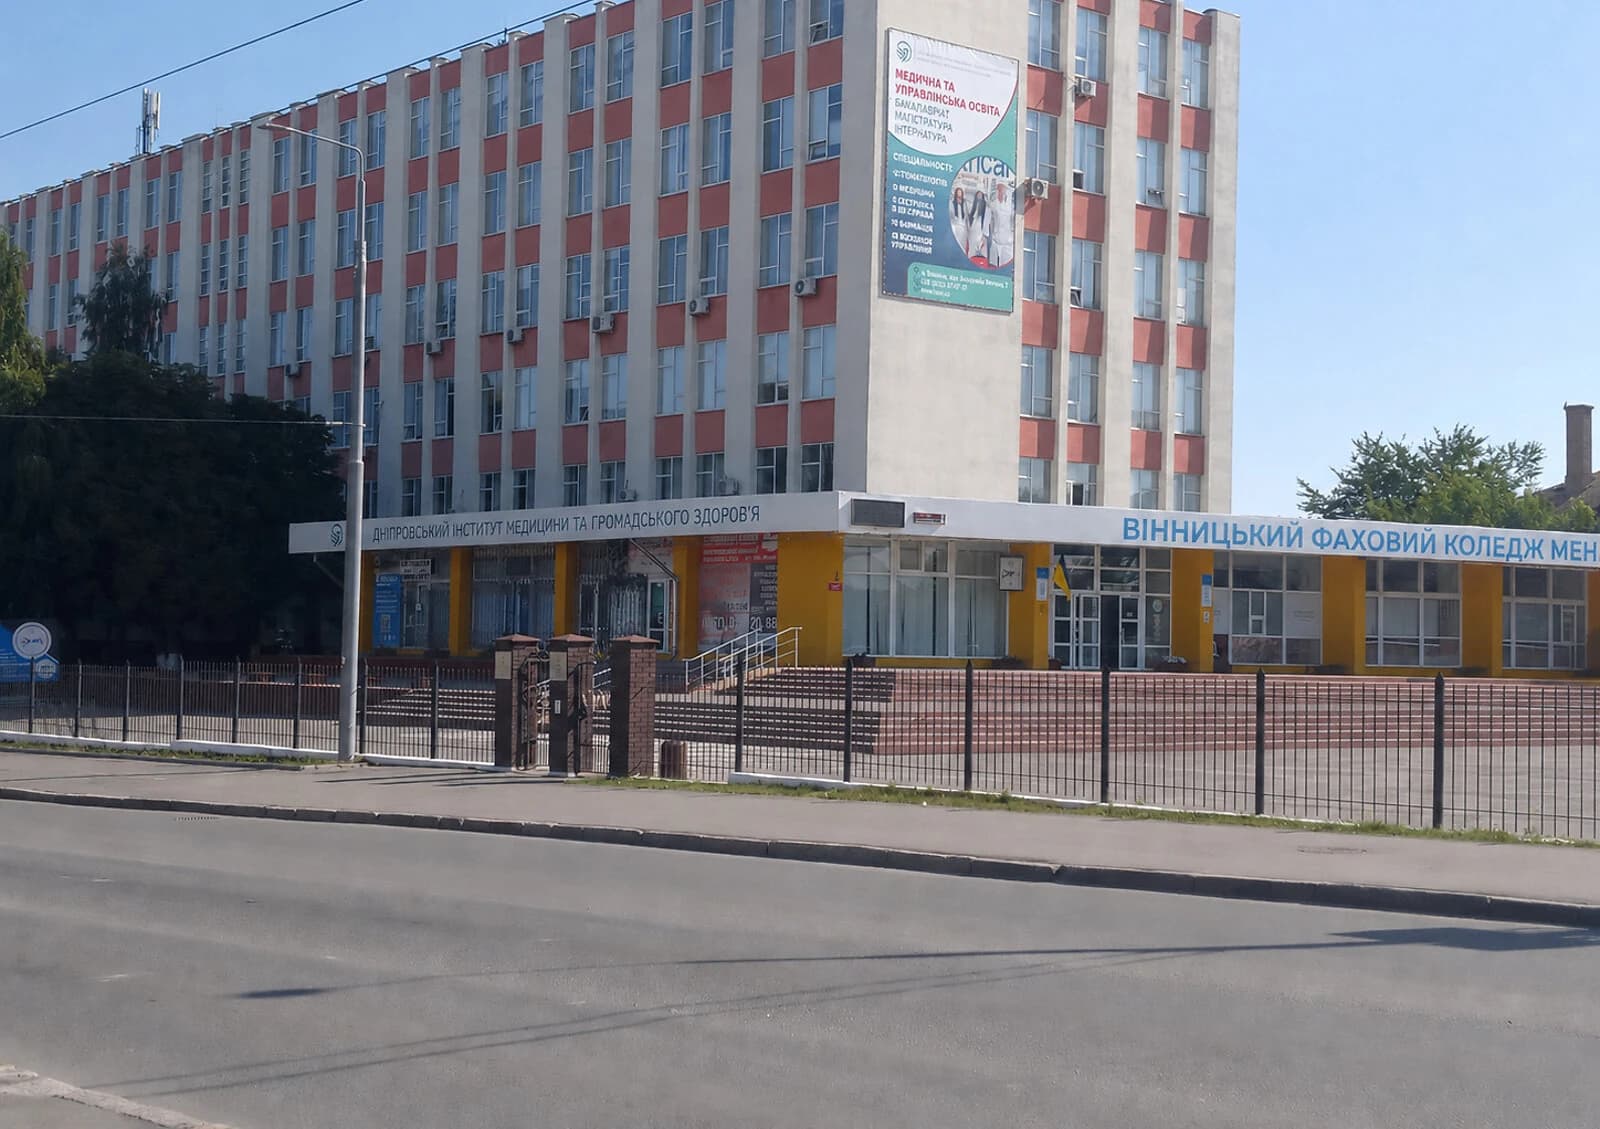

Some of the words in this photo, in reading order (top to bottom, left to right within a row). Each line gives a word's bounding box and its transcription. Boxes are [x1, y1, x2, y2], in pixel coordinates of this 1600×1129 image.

[895, 68, 941, 89] МЕДИЧНА
[943, 80, 955, 93] ТА
[895, 83, 966, 109] УПРАВЛІНСЬКА
[968, 101, 1000, 117] ОСВІТА
[895, 124, 948, 144] ІНТЕРНАТУРА
[372, 521, 449, 542] ДНІПРОВСЬКИЙ
[452, 520, 503, 537] ІНСТИТУТ
[506, 517, 569, 537] МЕДИЦИНИ
[573, 516, 587, 530] ТА
[591, 509, 689, 530] ГРОМАДСЬКОГО
[694, 505, 760, 525] ЗДОРОВ'Я
[1123, 517, 1303, 548] ВІННИЦЬКИЙ
[1312, 527, 1436, 554] ФАХОВИЙ
[1445, 534, 1544, 561] КОЛЕДЖ
[1551, 540, 1597, 561] МЕН
